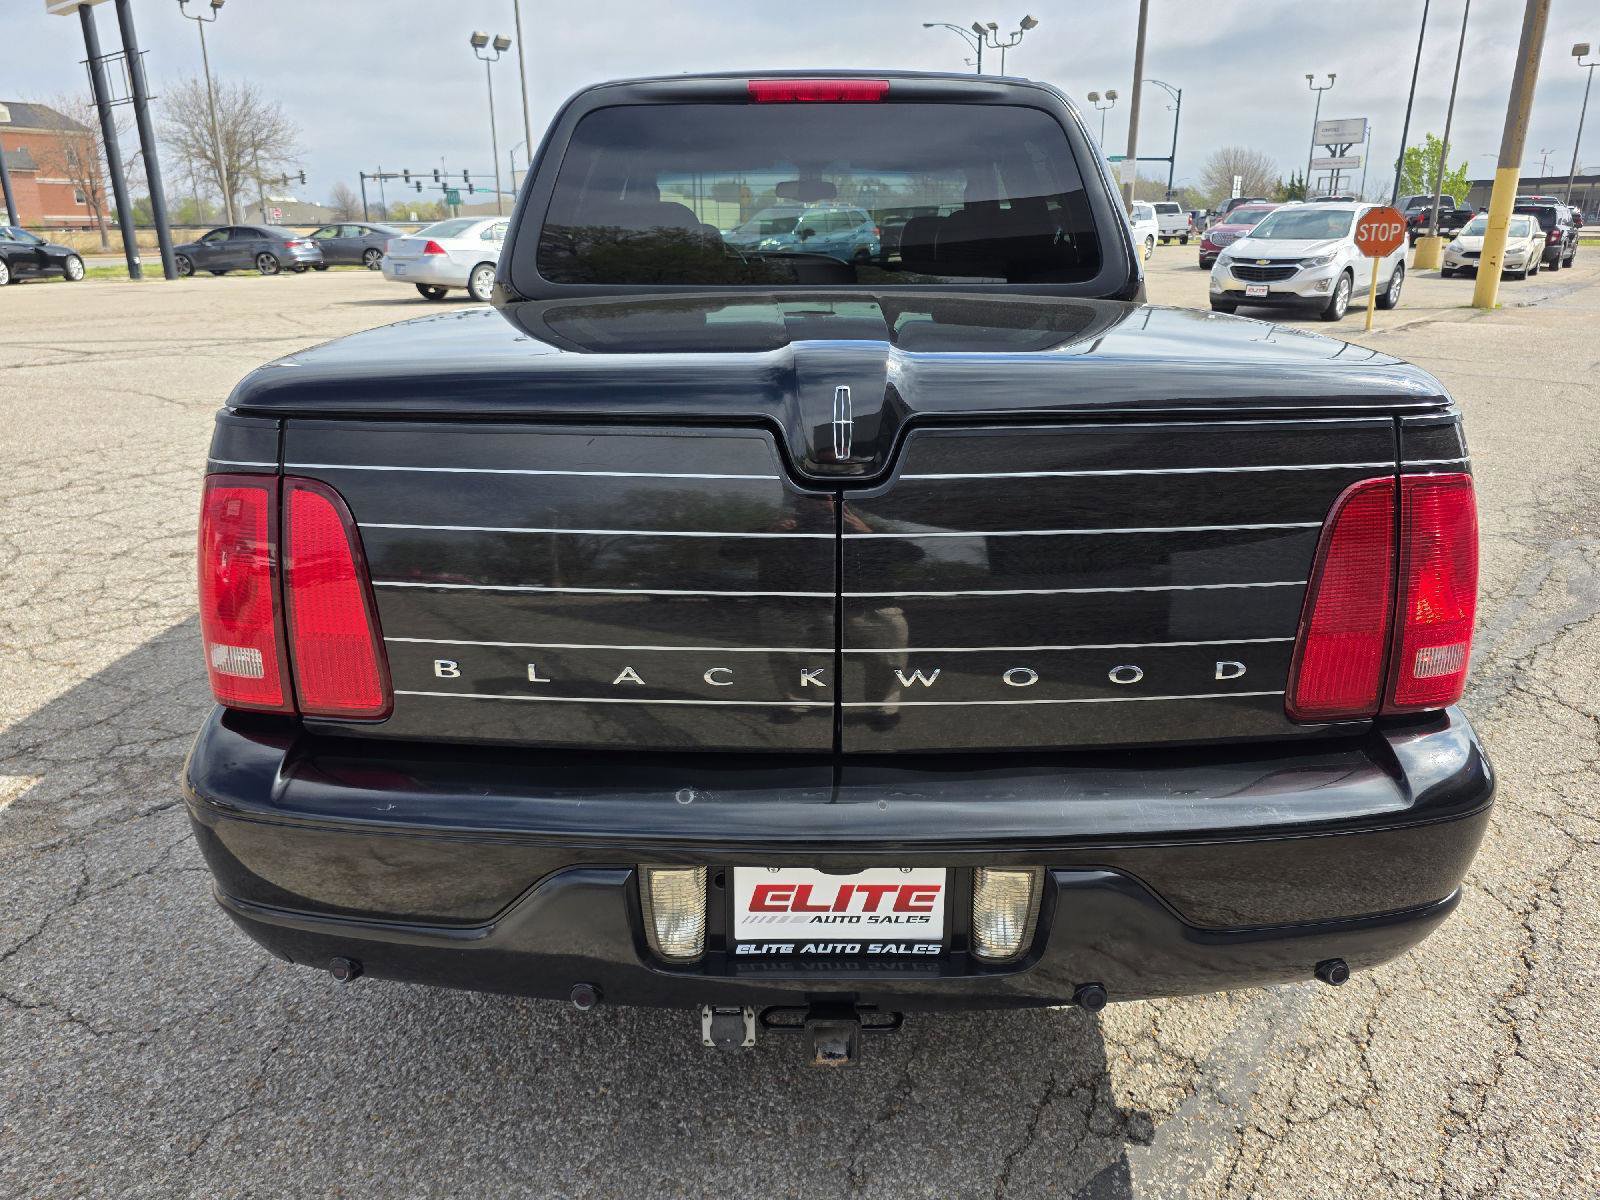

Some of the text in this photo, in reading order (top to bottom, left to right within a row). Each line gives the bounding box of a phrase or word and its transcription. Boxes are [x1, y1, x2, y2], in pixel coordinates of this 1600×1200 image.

[1358, 223, 1401, 242] STOP
[434, 659, 1247, 687] BLACKWOOD
[748, 884, 942, 913] ELITE
[809, 915, 931, 924] AUTO SALES
[735, 943, 942, 955] ELITE AUTO SALES
